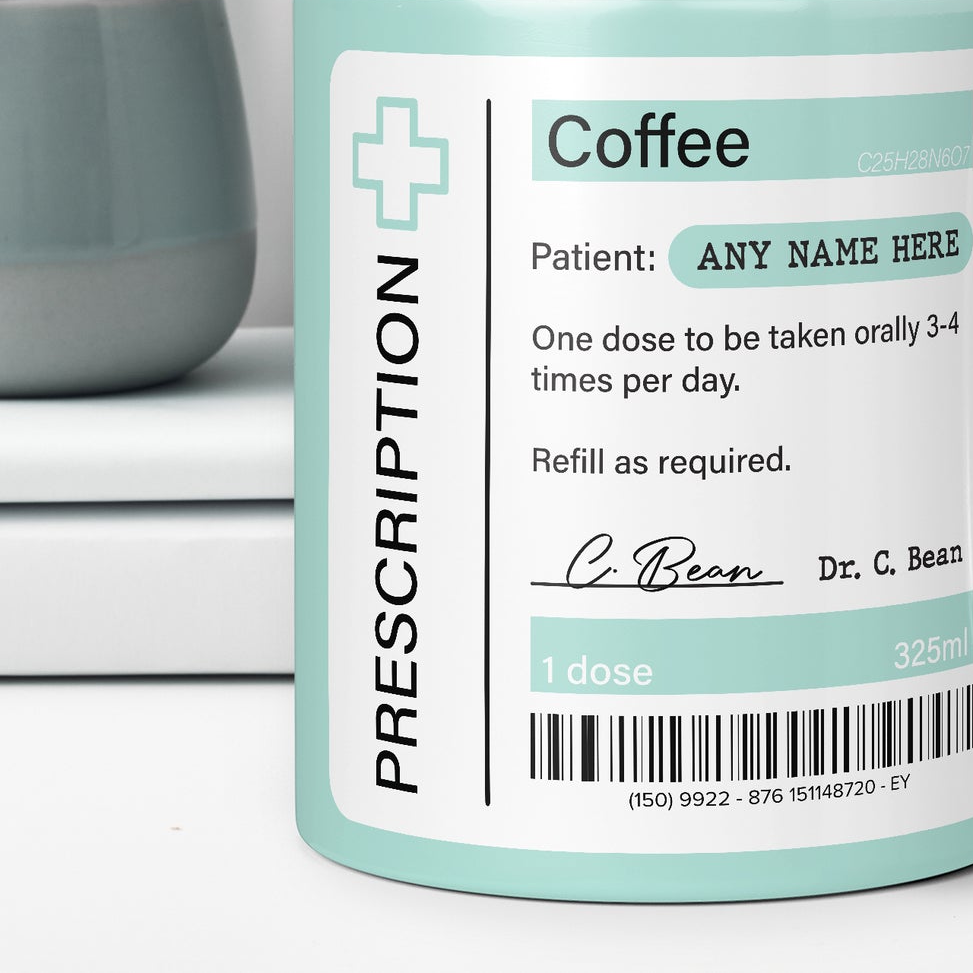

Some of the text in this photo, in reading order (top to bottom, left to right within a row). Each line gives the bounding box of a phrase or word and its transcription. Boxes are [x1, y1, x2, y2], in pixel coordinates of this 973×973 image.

[548, 111, 750, 169] Coffee
[531, 228, 960, 272] Patient: ANY NAME HERE
[532, 311, 960, 352] One dose to be taken orally 3-4
[530, 365, 740, 399] times per day.
[533, 445, 791, 481] Refill as required.
[374, 254, 420, 795] PRESCRIPTION
[566, 534, 763, 592] C. Bean
[818, 544, 963, 582] Dr. C. Bean
[894, 626, 969, 670] 325ml
[542, 654, 653, 686] 1 dose
[628, 792, 673, 811] (150)
[679, 790, 730, 808] 9922
[748, 788, 784, 805] 876
[789, 779, 876, 802] 151148720
[890, 773, 911, 792] EY
